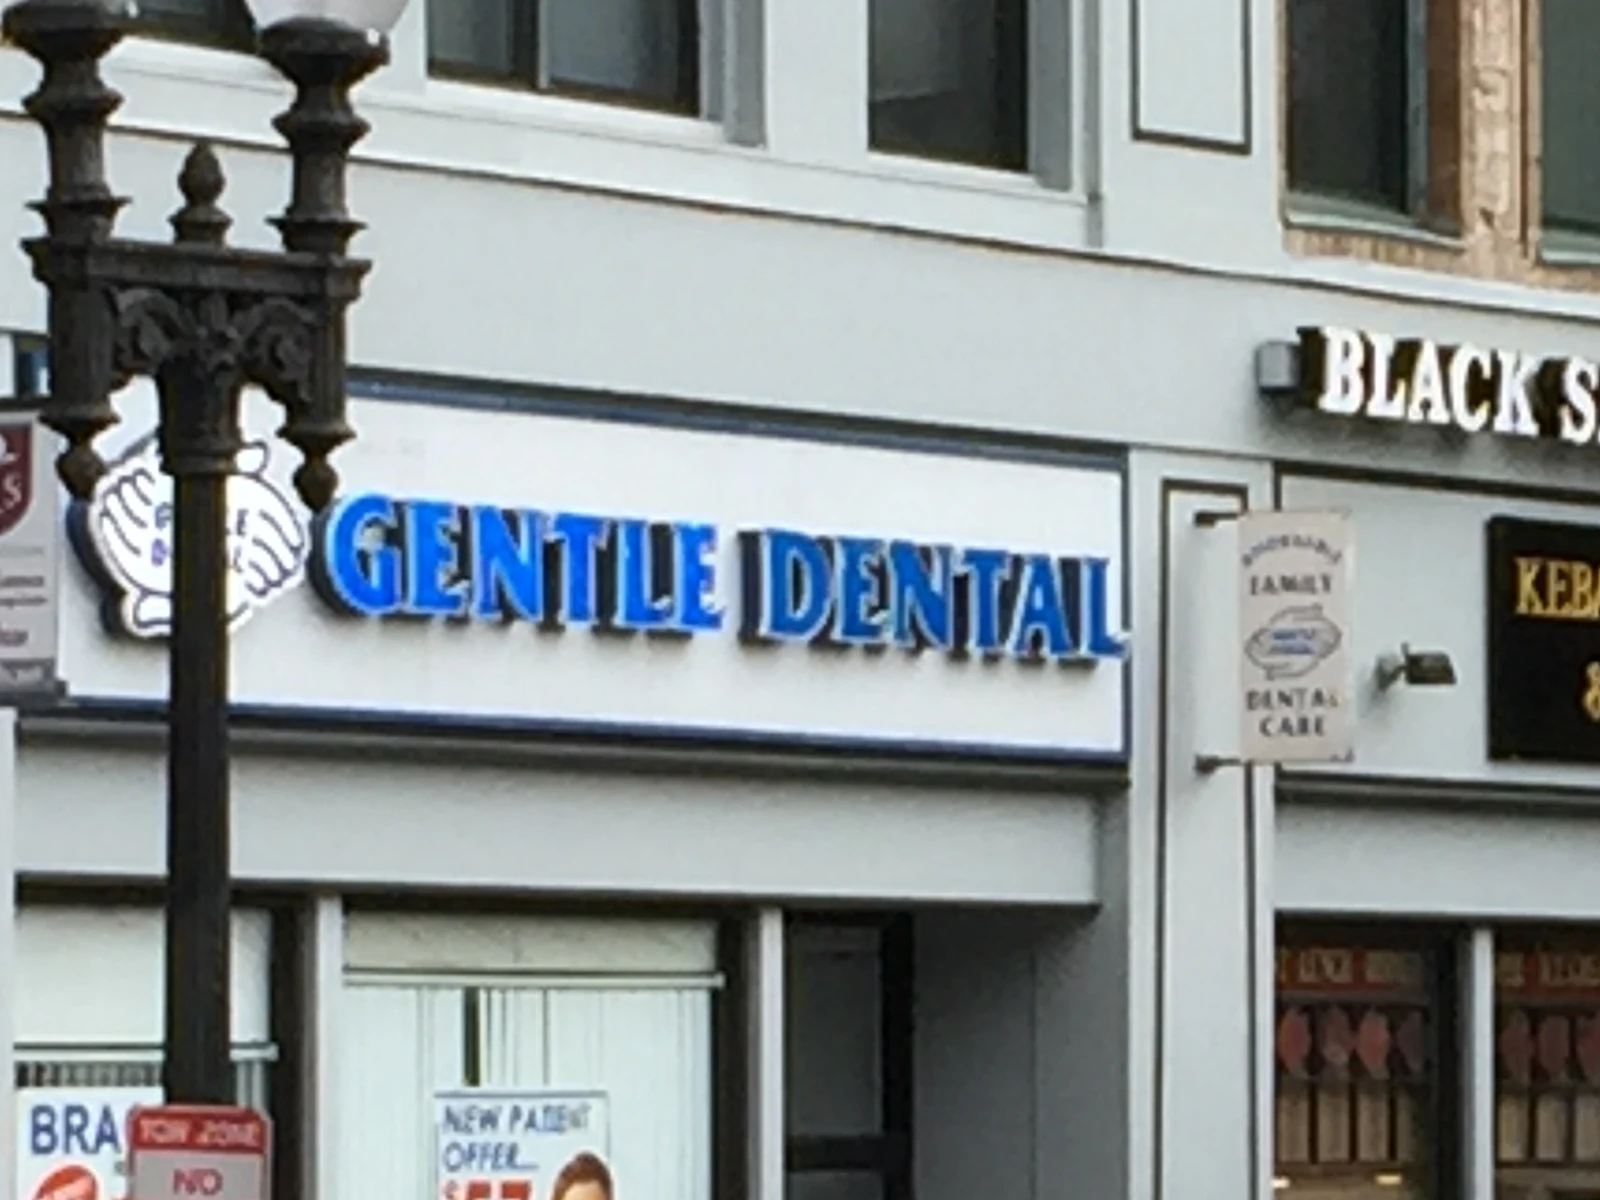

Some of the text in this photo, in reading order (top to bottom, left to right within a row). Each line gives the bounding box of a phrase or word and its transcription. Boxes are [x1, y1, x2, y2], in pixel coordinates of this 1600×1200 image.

[1318, 325, 1546, 438] BLACK
[325, 492, 724, 634] GENTLE
[758, 526, 1130, 658] DENTAL
[1258, 715, 1326, 738] CARE
[172, 1167, 224, 1196] NO
